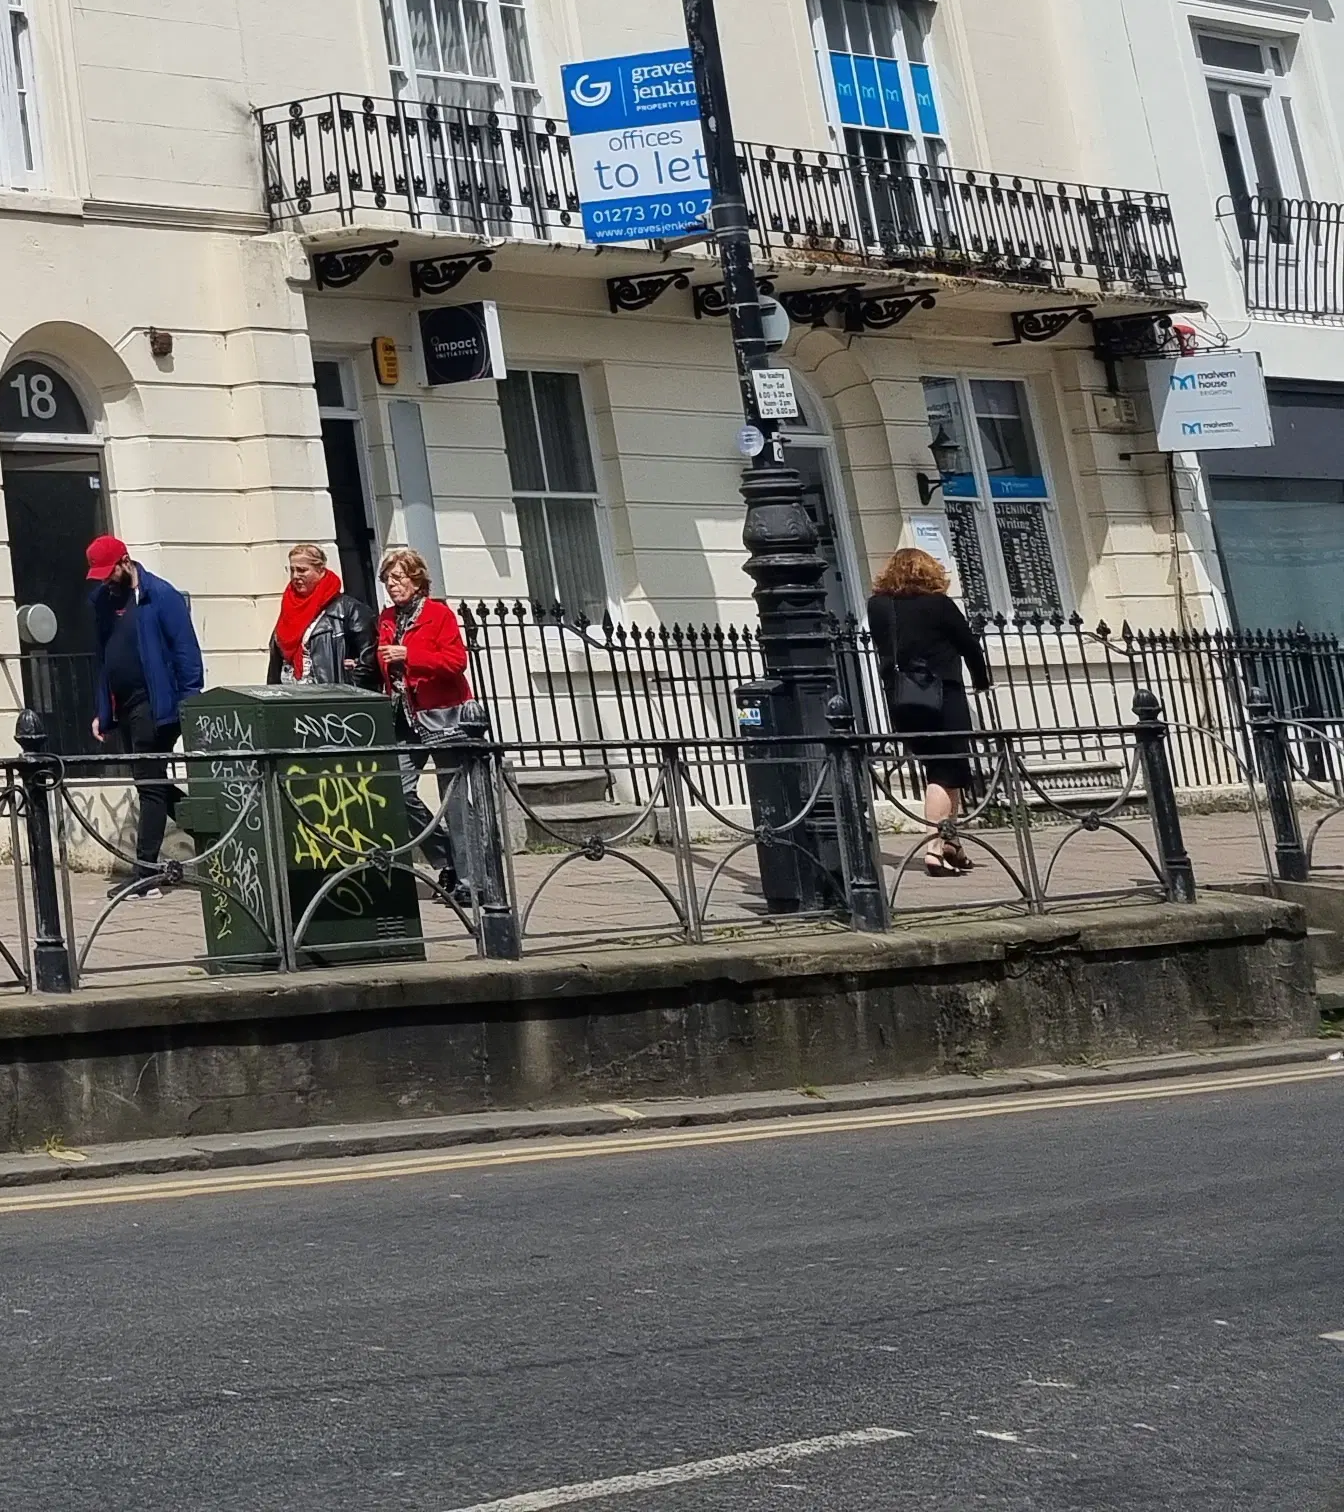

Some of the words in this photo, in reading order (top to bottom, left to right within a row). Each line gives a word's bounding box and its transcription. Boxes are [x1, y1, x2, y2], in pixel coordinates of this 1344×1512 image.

[631, 60, 694, 84] graves
[632, 79, 698, 104] jenkin
[636, 101, 678, 112] PROPERTY
[608, 129, 683, 152] offices
[594, 160, 639, 191] to
[654, 149, 709, 185] let
[593, 205, 645, 224] 01273
[650, 203, 672, 219] 70
[677, 201, 696, 215] 10
[434, 337, 477, 352] impact
[10, 373, 57, 419] 18
[1198, 381, 1227, 389] house
